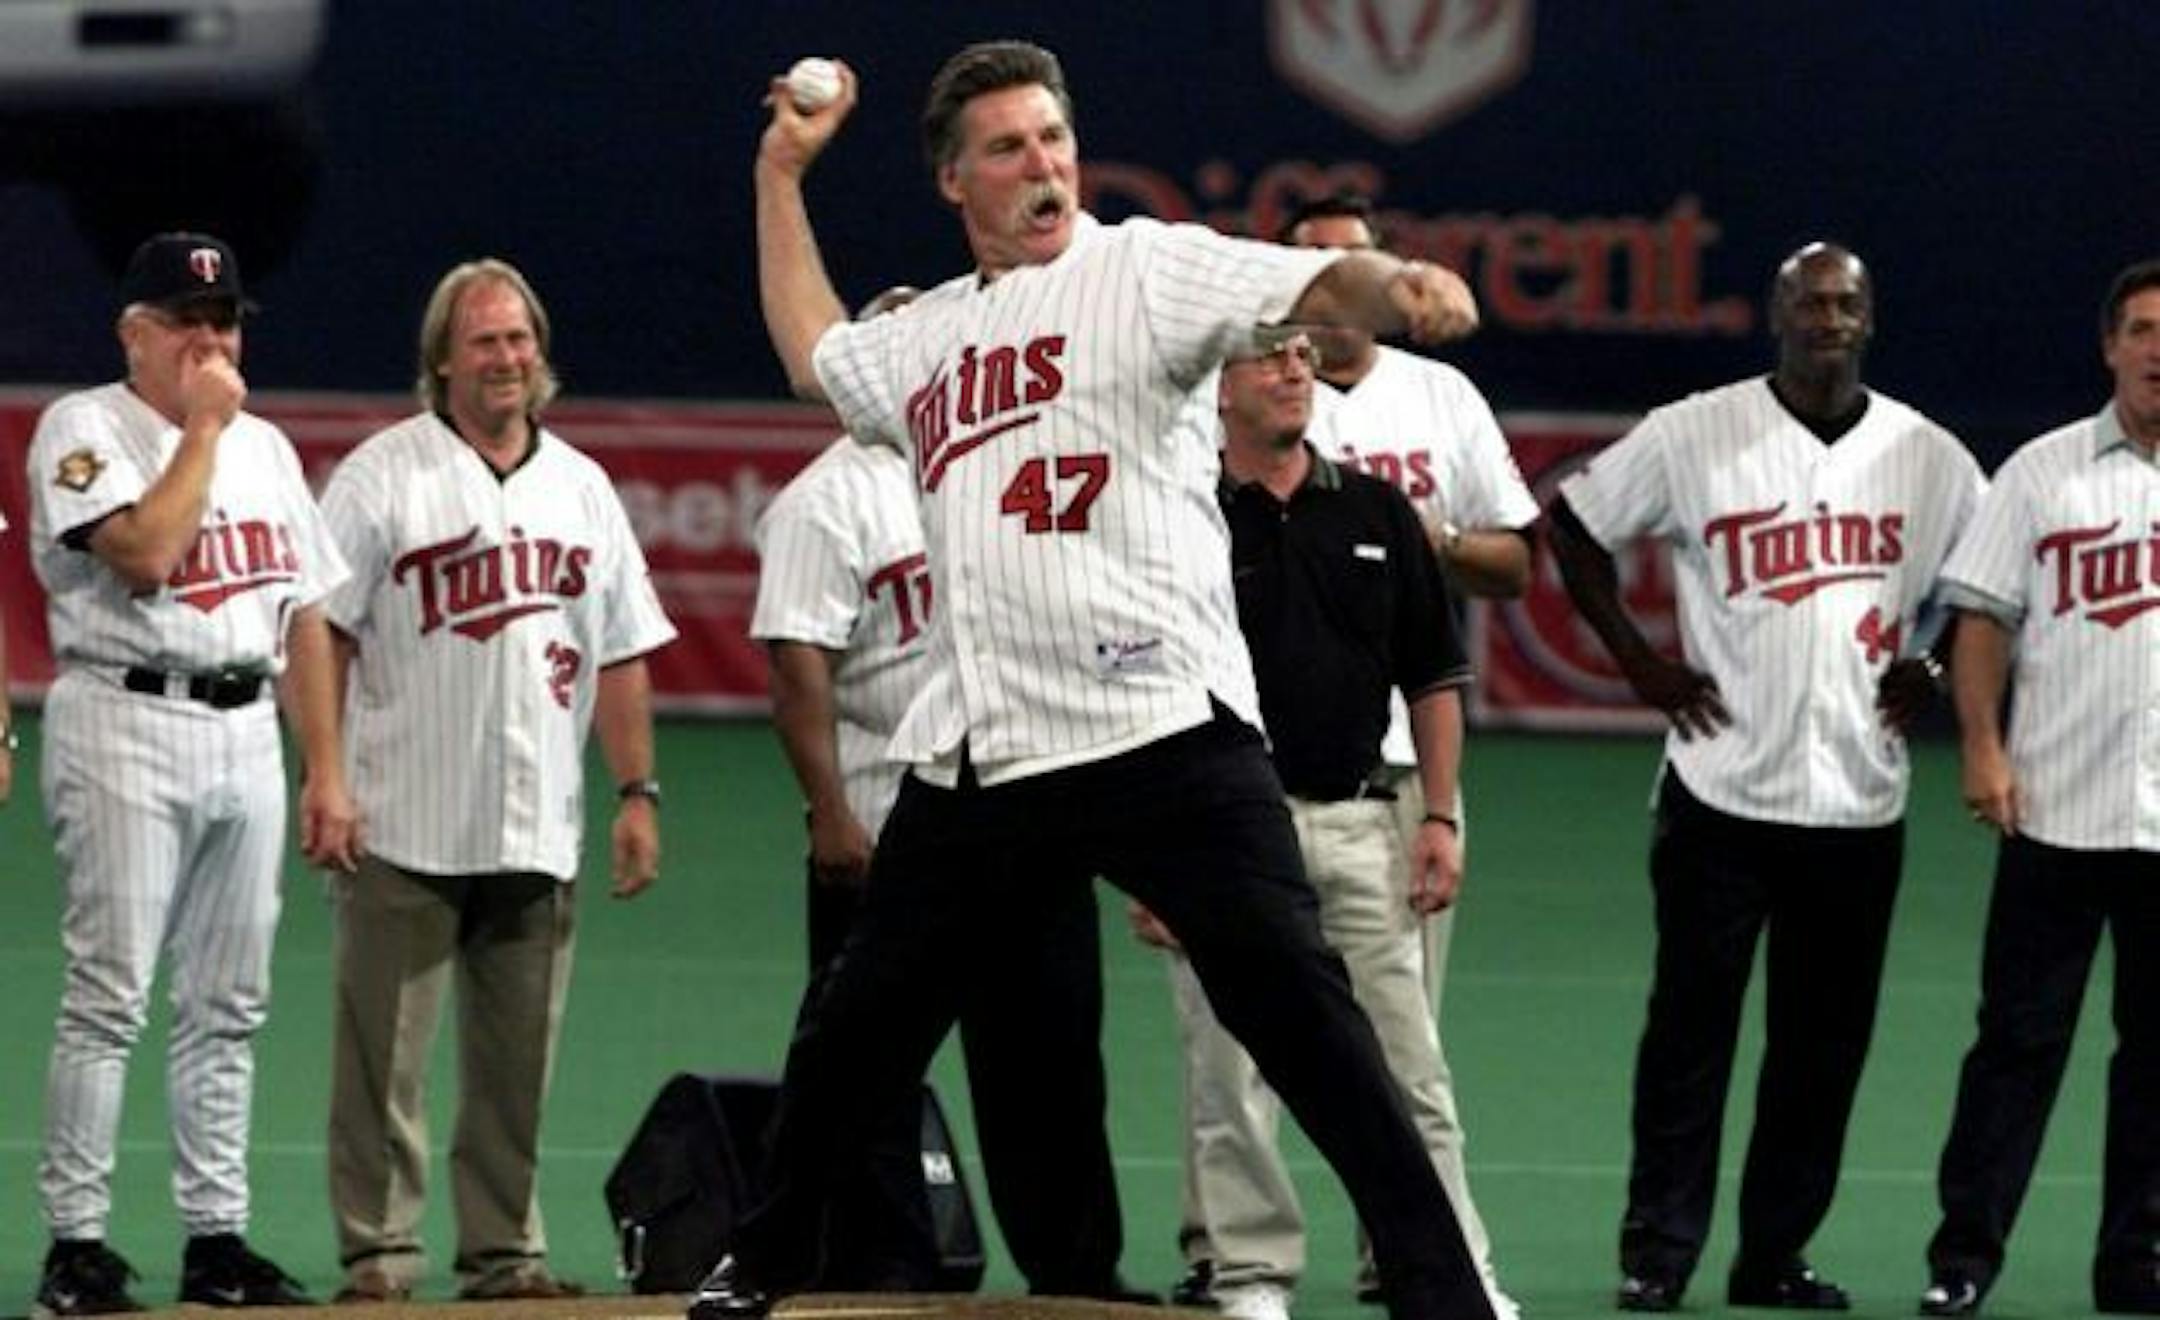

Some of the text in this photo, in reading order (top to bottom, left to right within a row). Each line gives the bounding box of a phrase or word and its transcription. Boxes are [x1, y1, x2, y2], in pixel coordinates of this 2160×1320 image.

[1001, 454, 1108, 534] 47
[167, 507, 298, 600] wins
[394, 525, 592, 643] Twins
[1704, 501, 1903, 605] Twins
